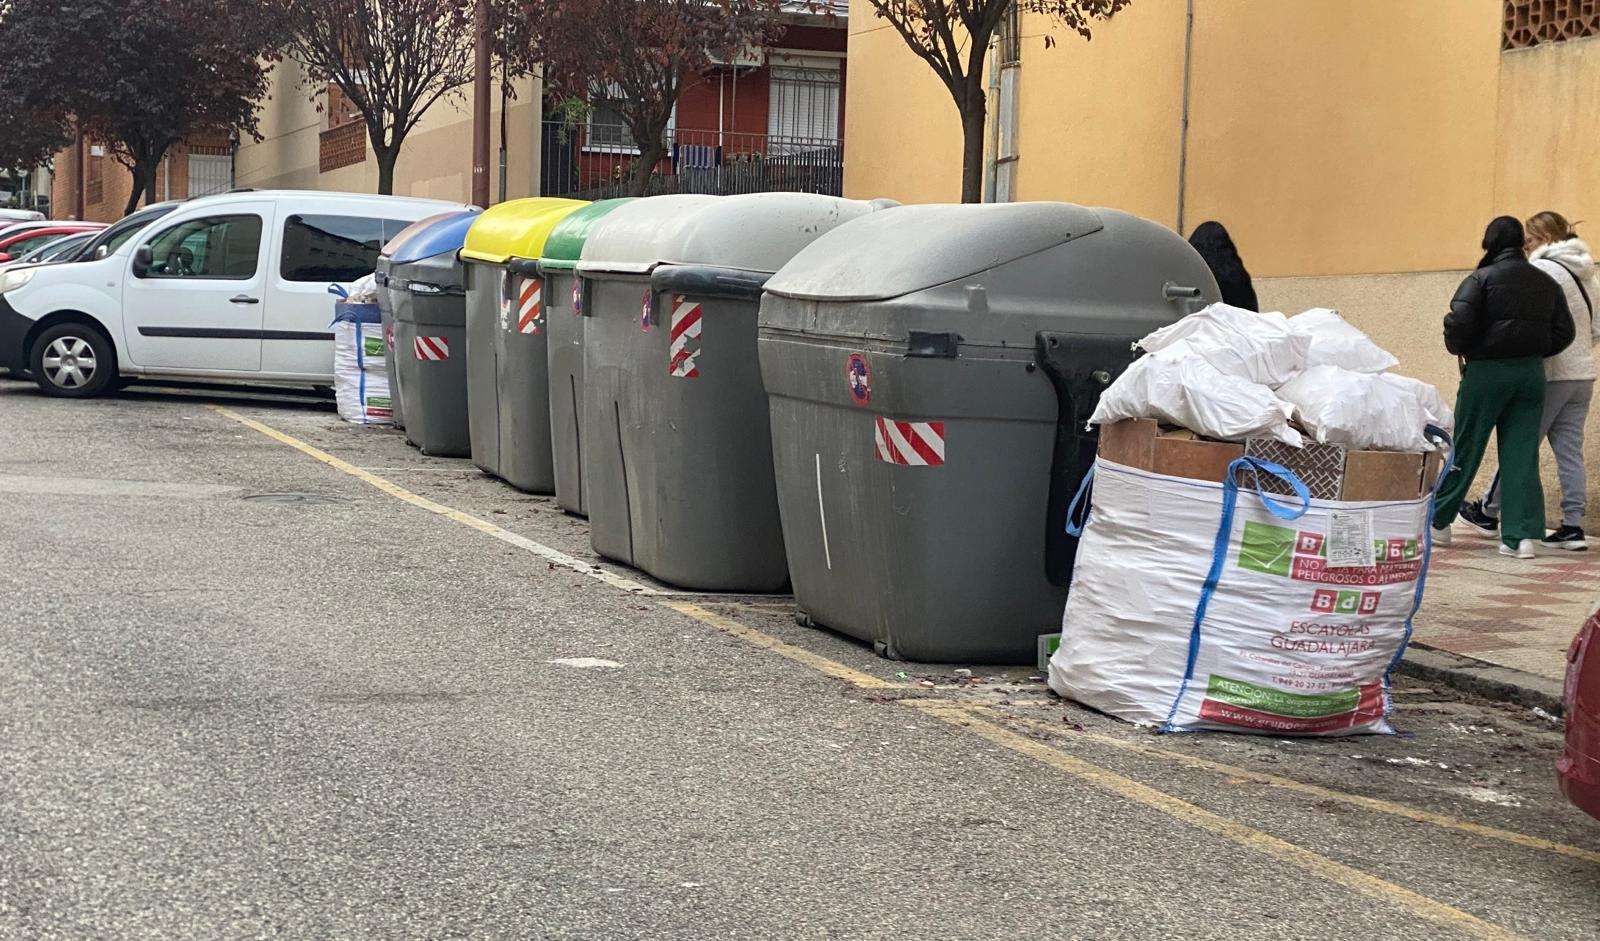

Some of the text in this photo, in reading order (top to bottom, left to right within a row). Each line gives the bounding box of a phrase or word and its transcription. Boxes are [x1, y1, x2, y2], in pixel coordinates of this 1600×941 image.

[1300, 559, 1320, 569] NO
[1297, 569, 1364, 584] PELIGROSOS
[1367, 575, 1376, 584] O
[1290, 621, 1370, 636] ESCAYOLAS
[1270, 636, 1376, 656] GUADALAJARA
